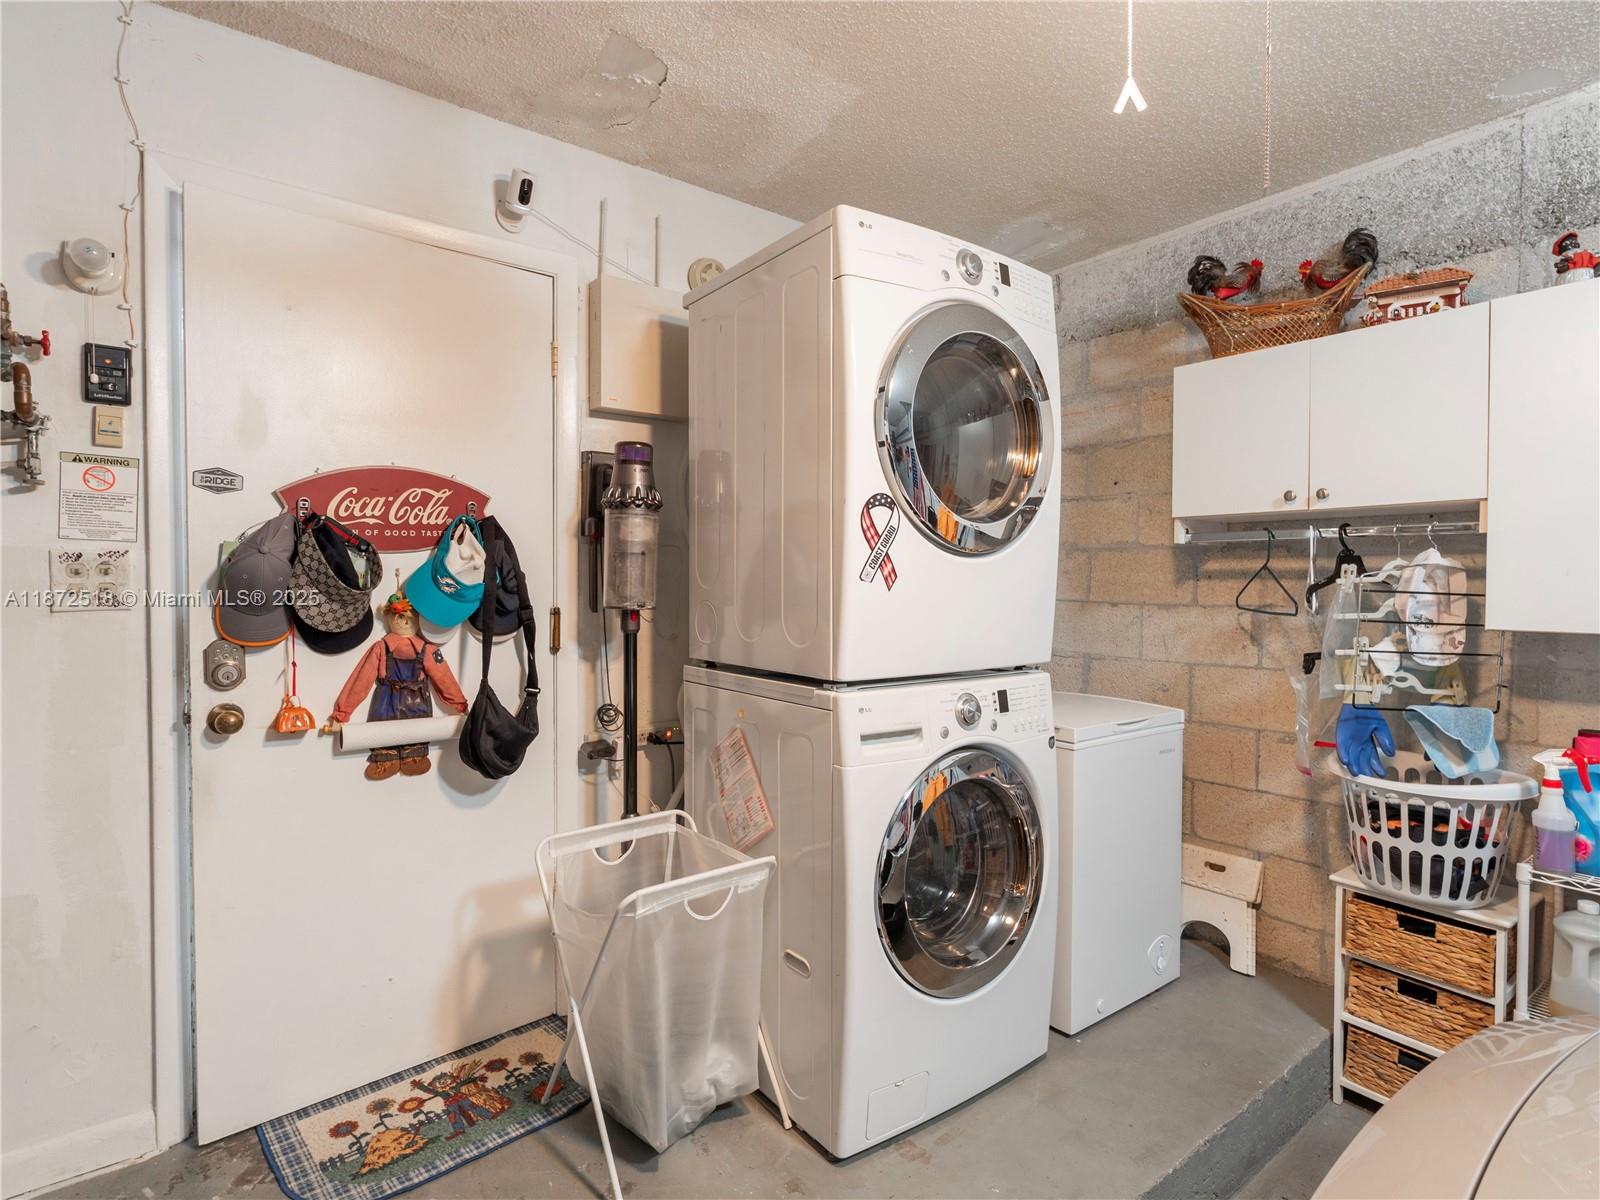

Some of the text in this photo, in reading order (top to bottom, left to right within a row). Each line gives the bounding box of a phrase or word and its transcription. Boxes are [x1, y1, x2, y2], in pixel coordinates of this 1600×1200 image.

[84, 456, 130, 467] WARNING
[205, 476, 236, 487] RIDGE
[326, 486, 453, 526] Coca-Cola
[365, 529, 379, 537] OF
[384, 529, 416, 538] GOOD
[421, 529, 444, 538] TAST
[868, 525, 896, 570] COAST GUARD
